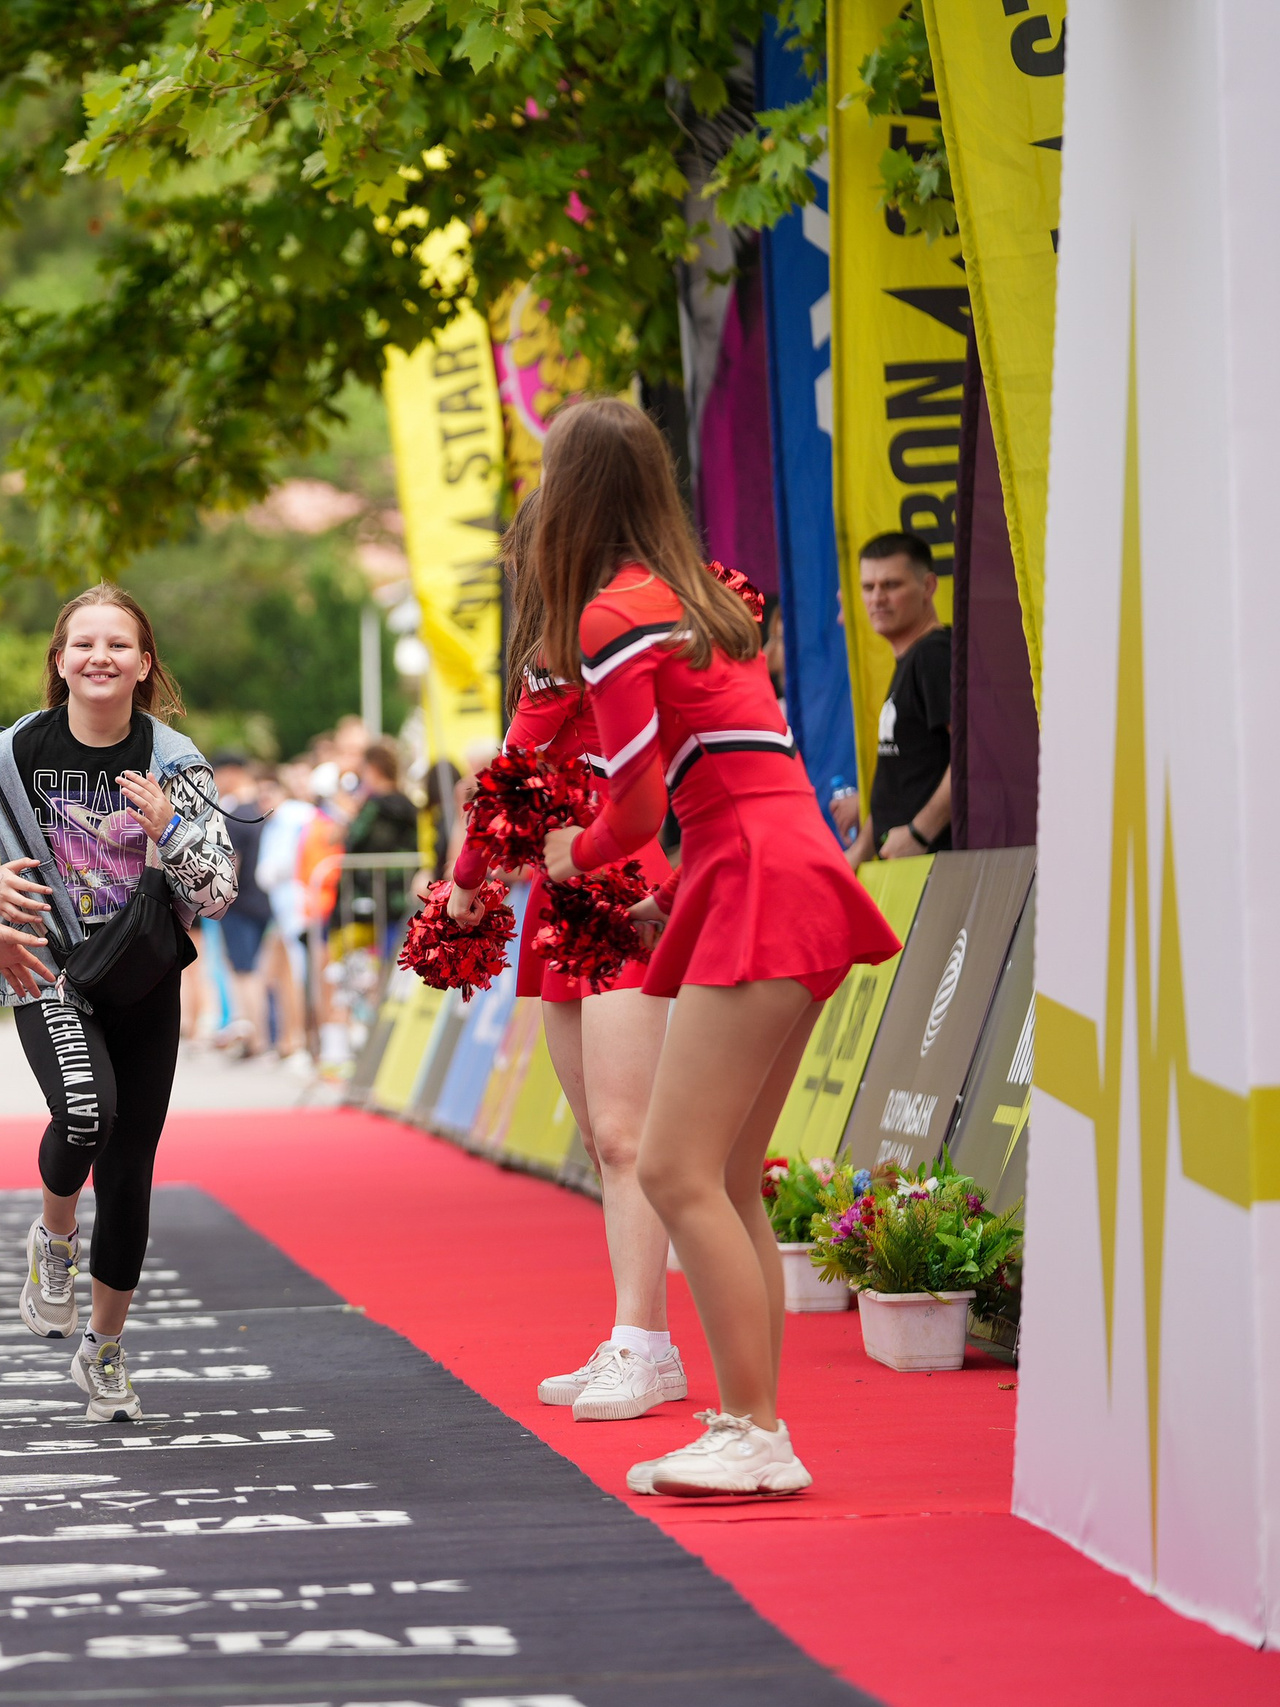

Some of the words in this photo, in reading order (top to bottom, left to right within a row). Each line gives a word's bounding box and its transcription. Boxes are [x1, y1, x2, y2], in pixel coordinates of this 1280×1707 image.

[431, 337, 492, 488] STAR
[884, 358, 969, 578] RON
[33, 769, 149, 832] SPAC
[41, 830, 144, 887] SPAC
[65, 1091, 101, 1148] PLAY
[1, 1364, 273, 1383] SAR
[25, 1428, 336, 1452] STAR
[53, 1509, 415, 1537] STAR
[85, 1625, 518, 1659] STAR
